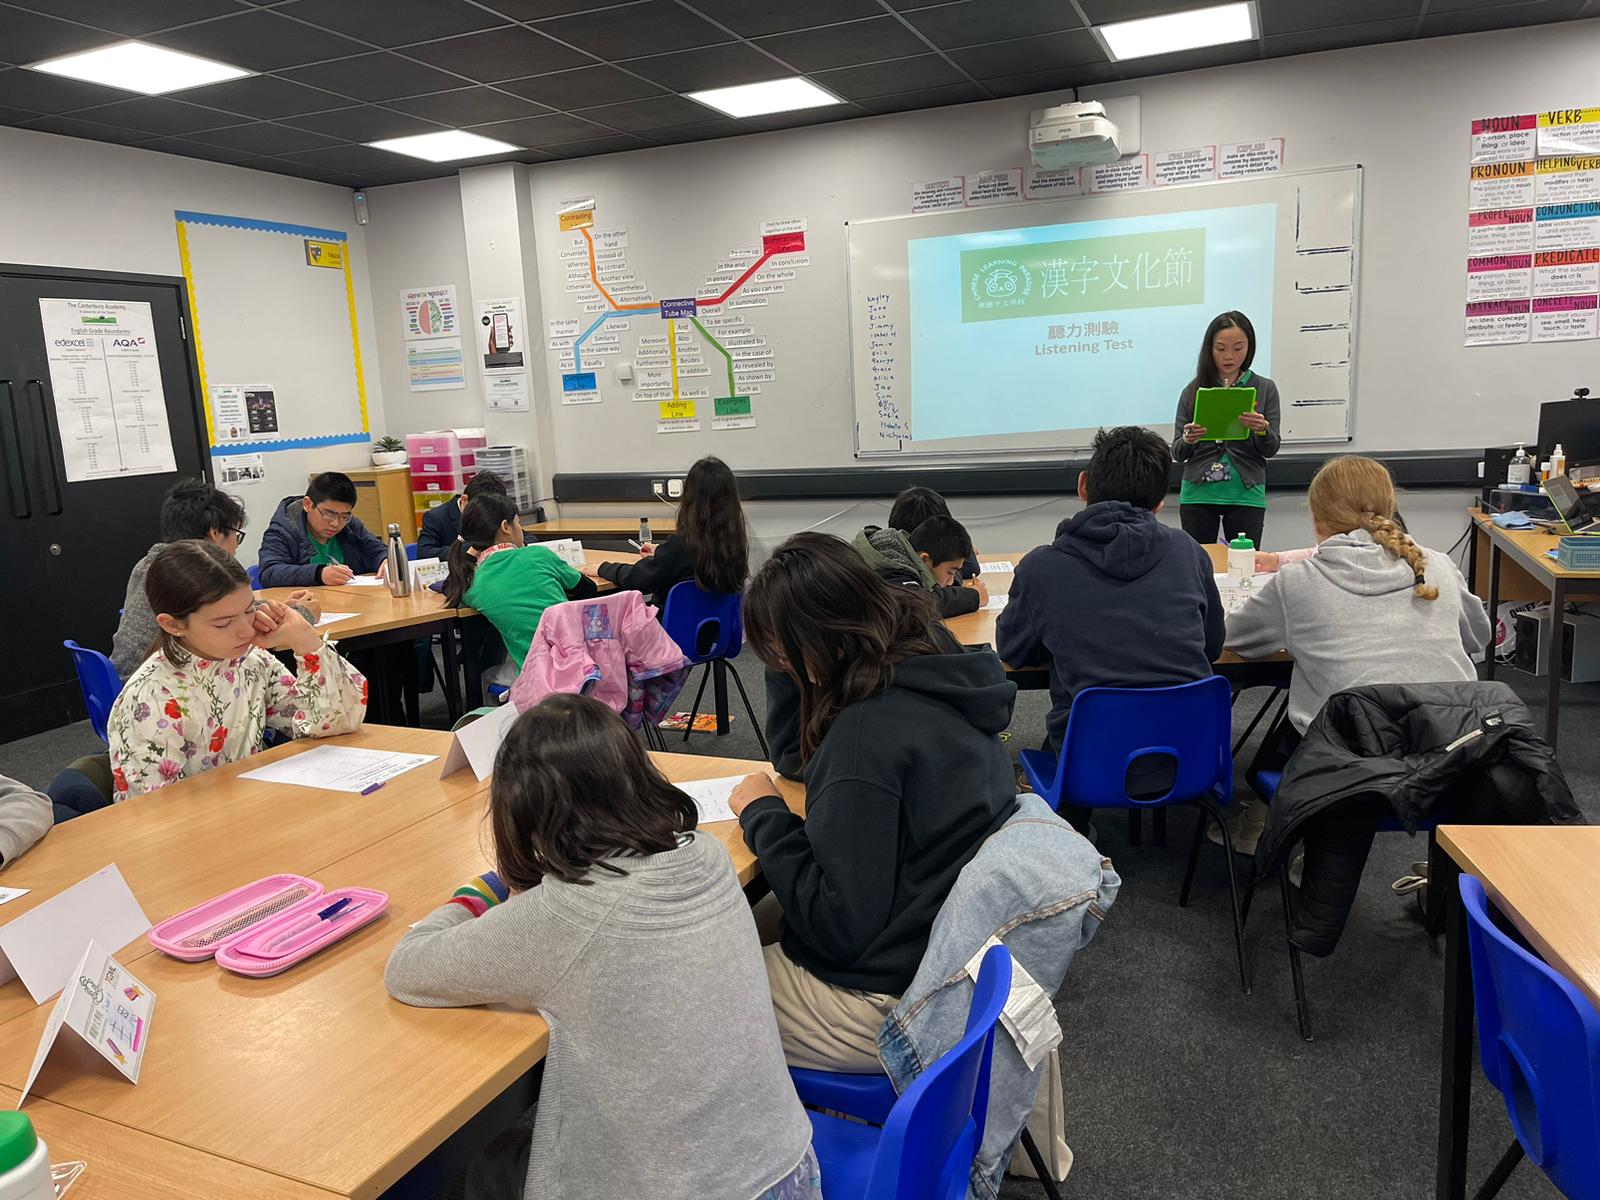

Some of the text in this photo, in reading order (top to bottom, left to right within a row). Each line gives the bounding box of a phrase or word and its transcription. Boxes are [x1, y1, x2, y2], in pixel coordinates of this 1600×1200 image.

[1482, 115, 1520, 132] NOUN
[1548, 109, 1582, 125] VERB
[1536, 156, 1576, 169] HELPING
[1471, 162, 1525, 179] PRONOUN
[560, 212, 592, 221] Contrasting
[1478, 210, 1533, 223] PROPER NOUN
[560, 250, 587, 258] Conversely
[1535, 248, 1599, 264] PREDICATE
[1468, 256, 1531, 269] COMMON NOUN
[600, 274, 621, 282] Another
[979, 259, 1017, 272] LEARNING
[1019, 265, 1032, 296] PARADISE
[1040, 247, 1192, 298] 漢字文化節
[662, 300, 694, 308] Connective
[735, 298, 766, 306] summation
[1466, 301, 1530, 314] ABSTRACT NOUN
[1533, 296, 1597, 309] CONCRETE NOUN
[722, 317, 742, 325] specific
[1048, 321, 1119, 340] 聽力測驗
[55, 338, 85, 347] edexcel
[1034, 339, 1133, 356] Listening Test
